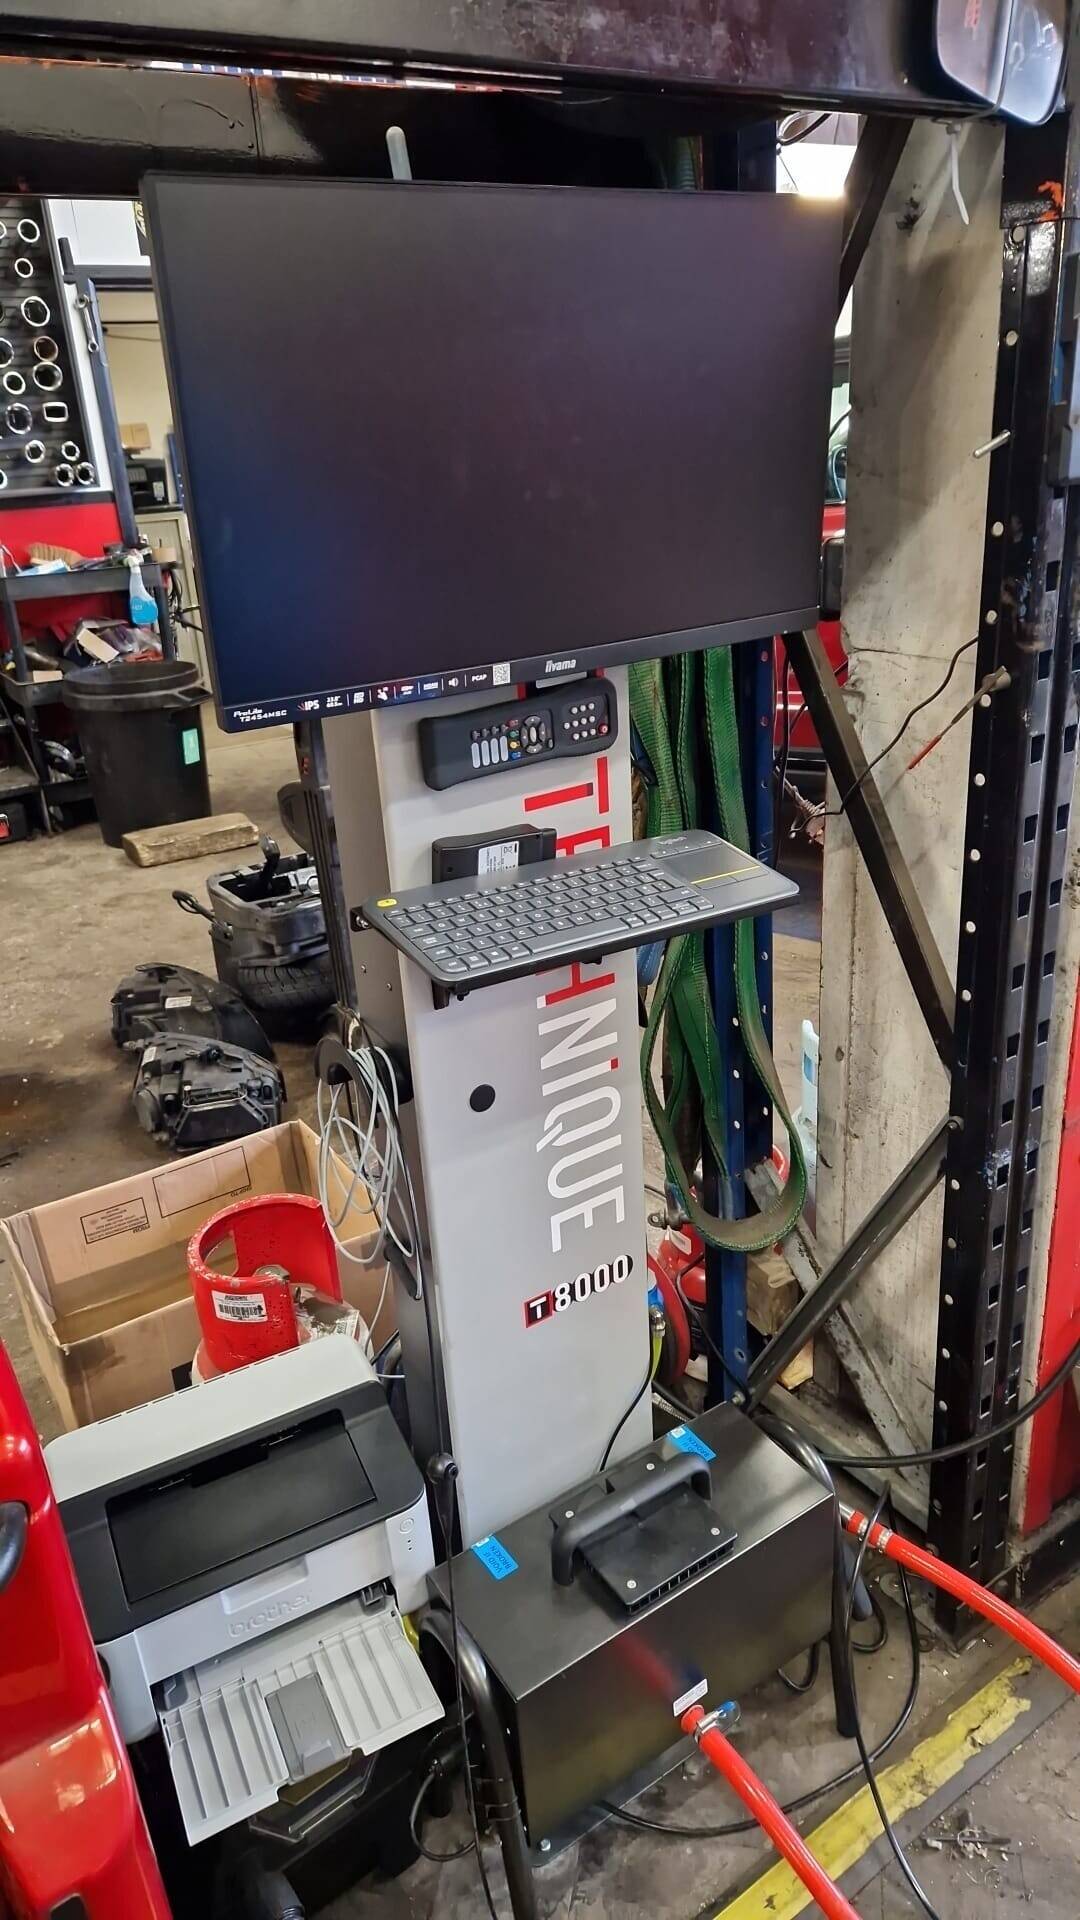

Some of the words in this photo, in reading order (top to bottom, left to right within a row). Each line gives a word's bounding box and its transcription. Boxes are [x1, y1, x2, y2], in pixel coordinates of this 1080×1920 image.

[471, 674, 489, 682] PCAP
[304, 699, 320, 711] IPS
[240, 709, 288, 723] T2454MSC
[525, 1255, 632, 1326] T8000
[227, 1591, 312, 1638] brother
